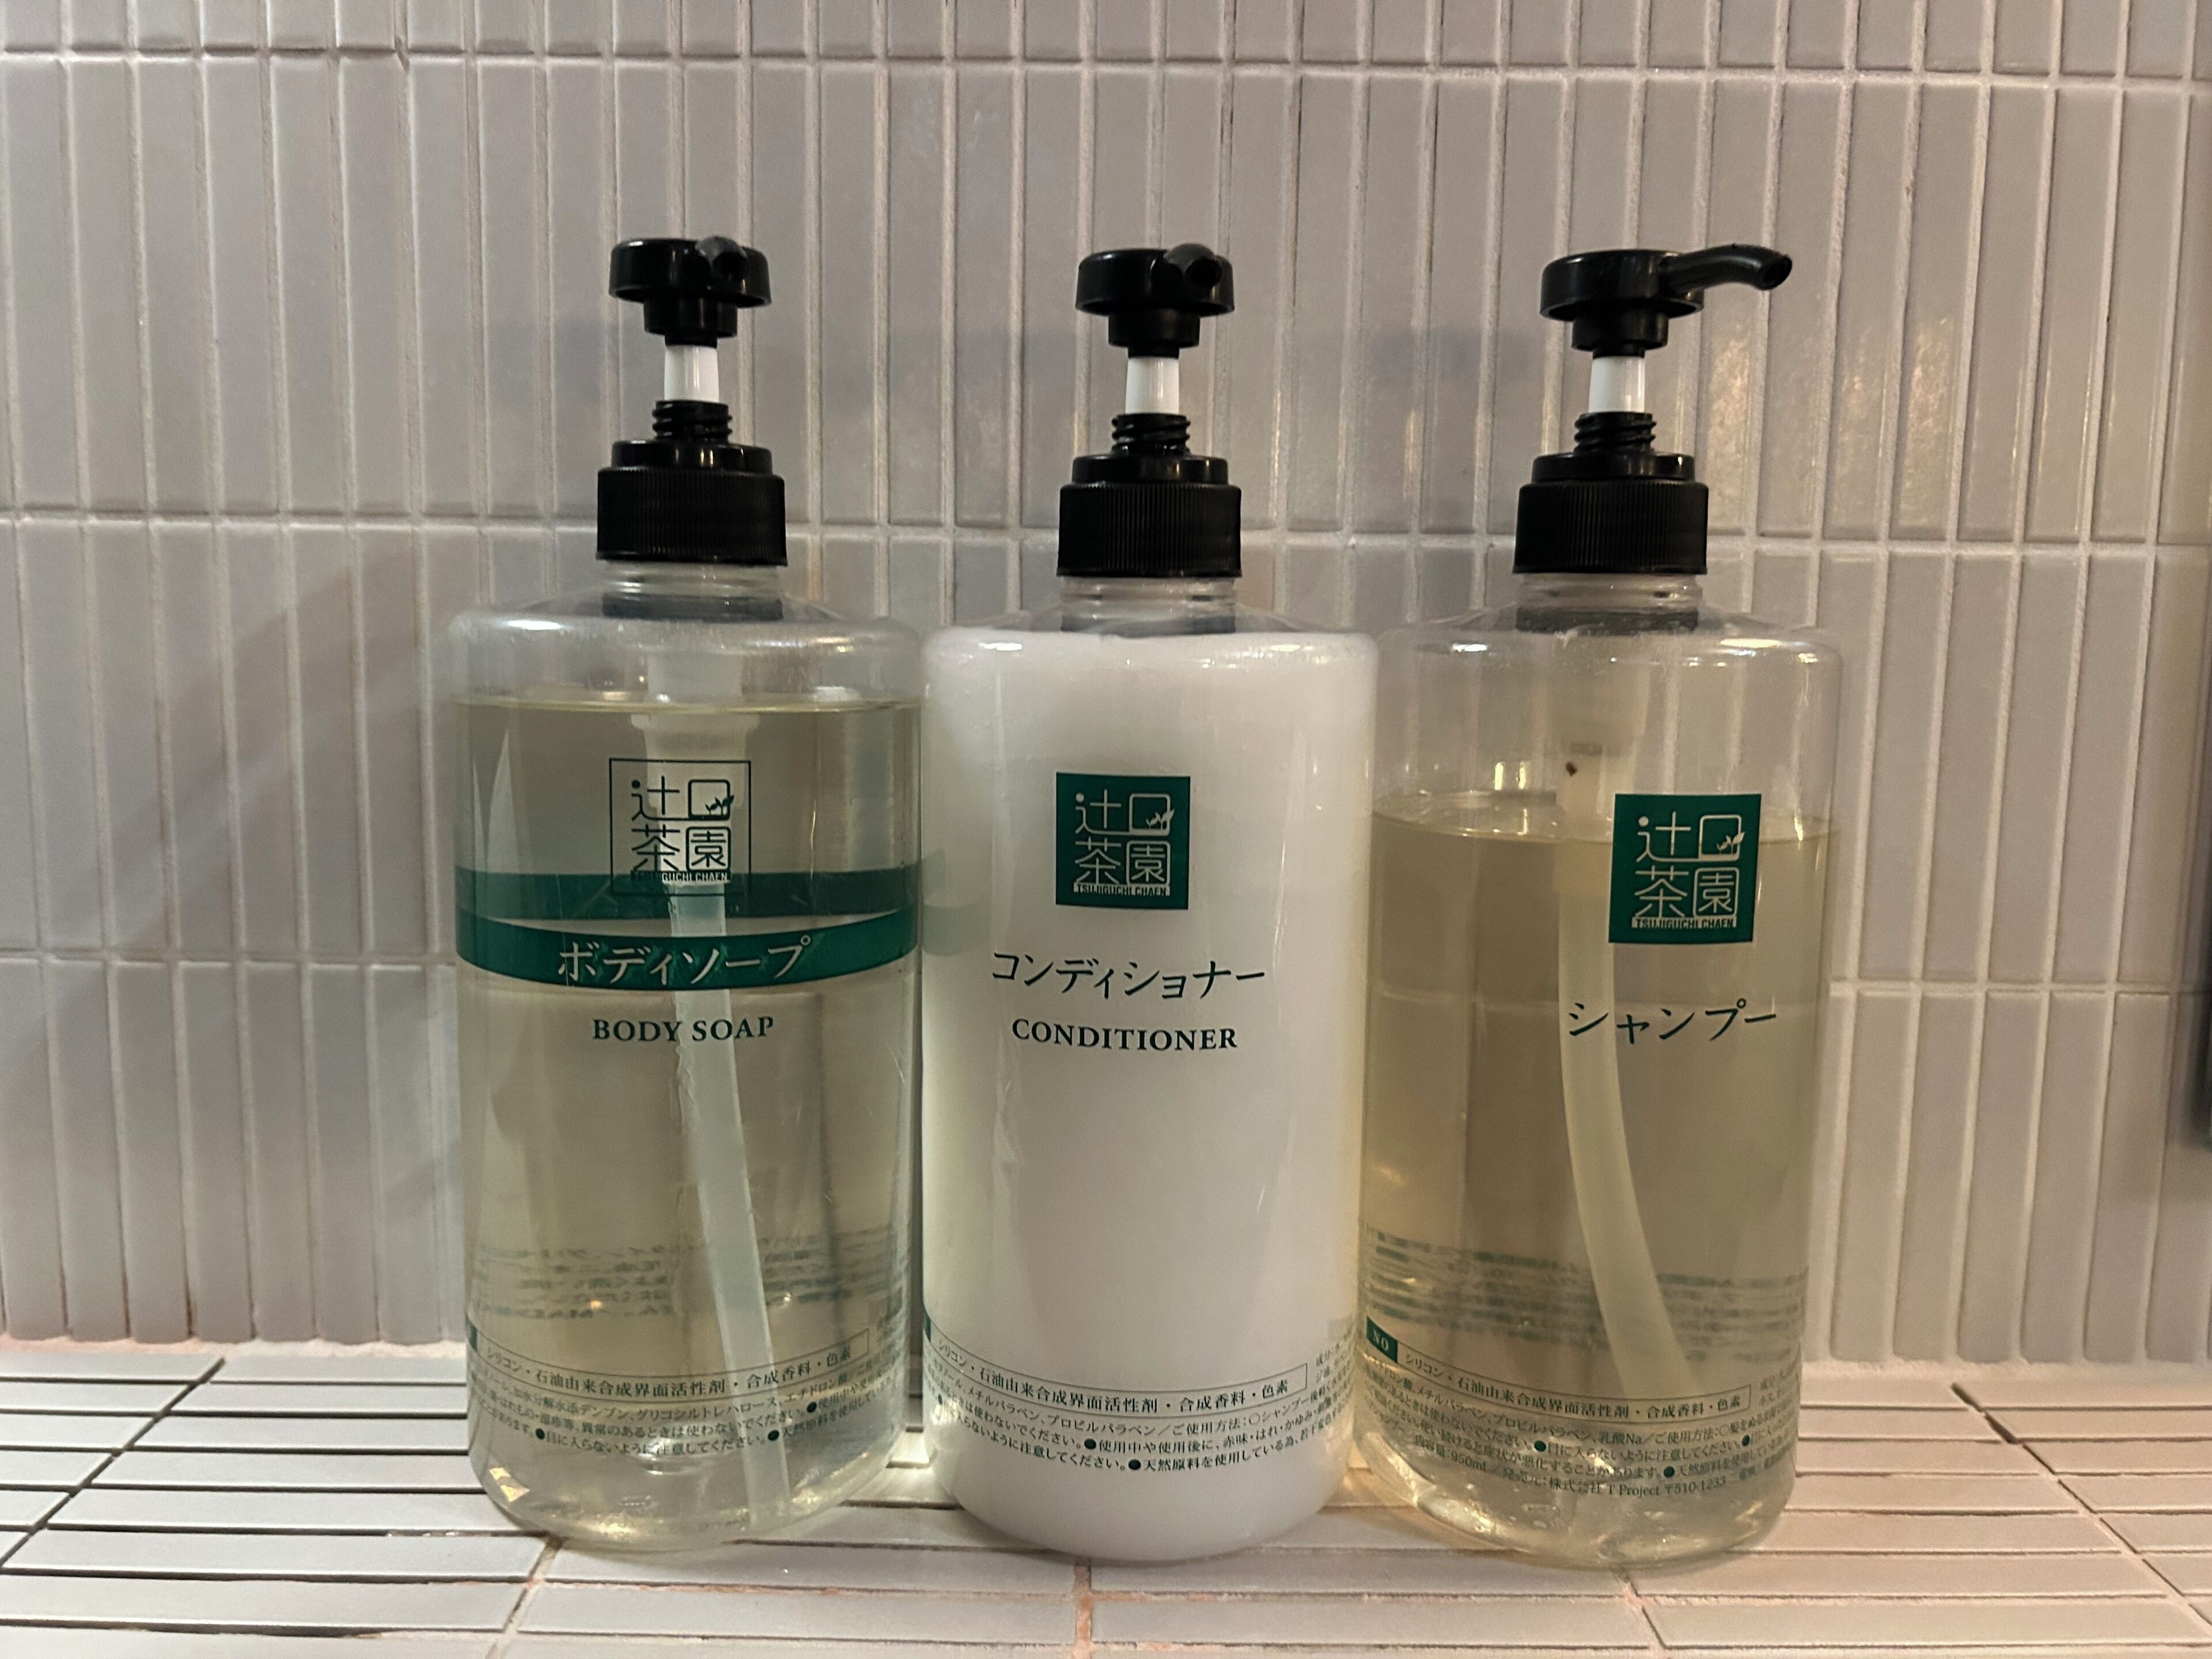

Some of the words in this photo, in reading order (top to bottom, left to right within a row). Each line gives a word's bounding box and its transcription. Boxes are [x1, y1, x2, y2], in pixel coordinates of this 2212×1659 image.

[631, 824, 732, 872] 茶園
[1075, 837, 1171, 885] 茶園
[695, 872, 728, 881] CHAEN
[1077, 883, 1131, 895] TSUJIGUCHI
[1135, 886, 1166, 897] CHAEN
[1635, 865, 1740, 918] 茶園
[1636, 918, 1699, 929] TSUJIGUCHI
[1701, 917, 1734, 929] CHAEN
[558, 935, 812, 986] ボディソープ
[992, 952, 1266, 999] コンディショナー
[593, 1018, 681, 1041] BODY
[692, 1016, 774, 1042] SOAP
[1012, 1018, 1238, 1051] CONDITIONER
[1568, 998, 1777, 1044] シャンプー
[1373, 1330, 1389, 1351] NO
[1619, 1484, 1660, 1497] Project
